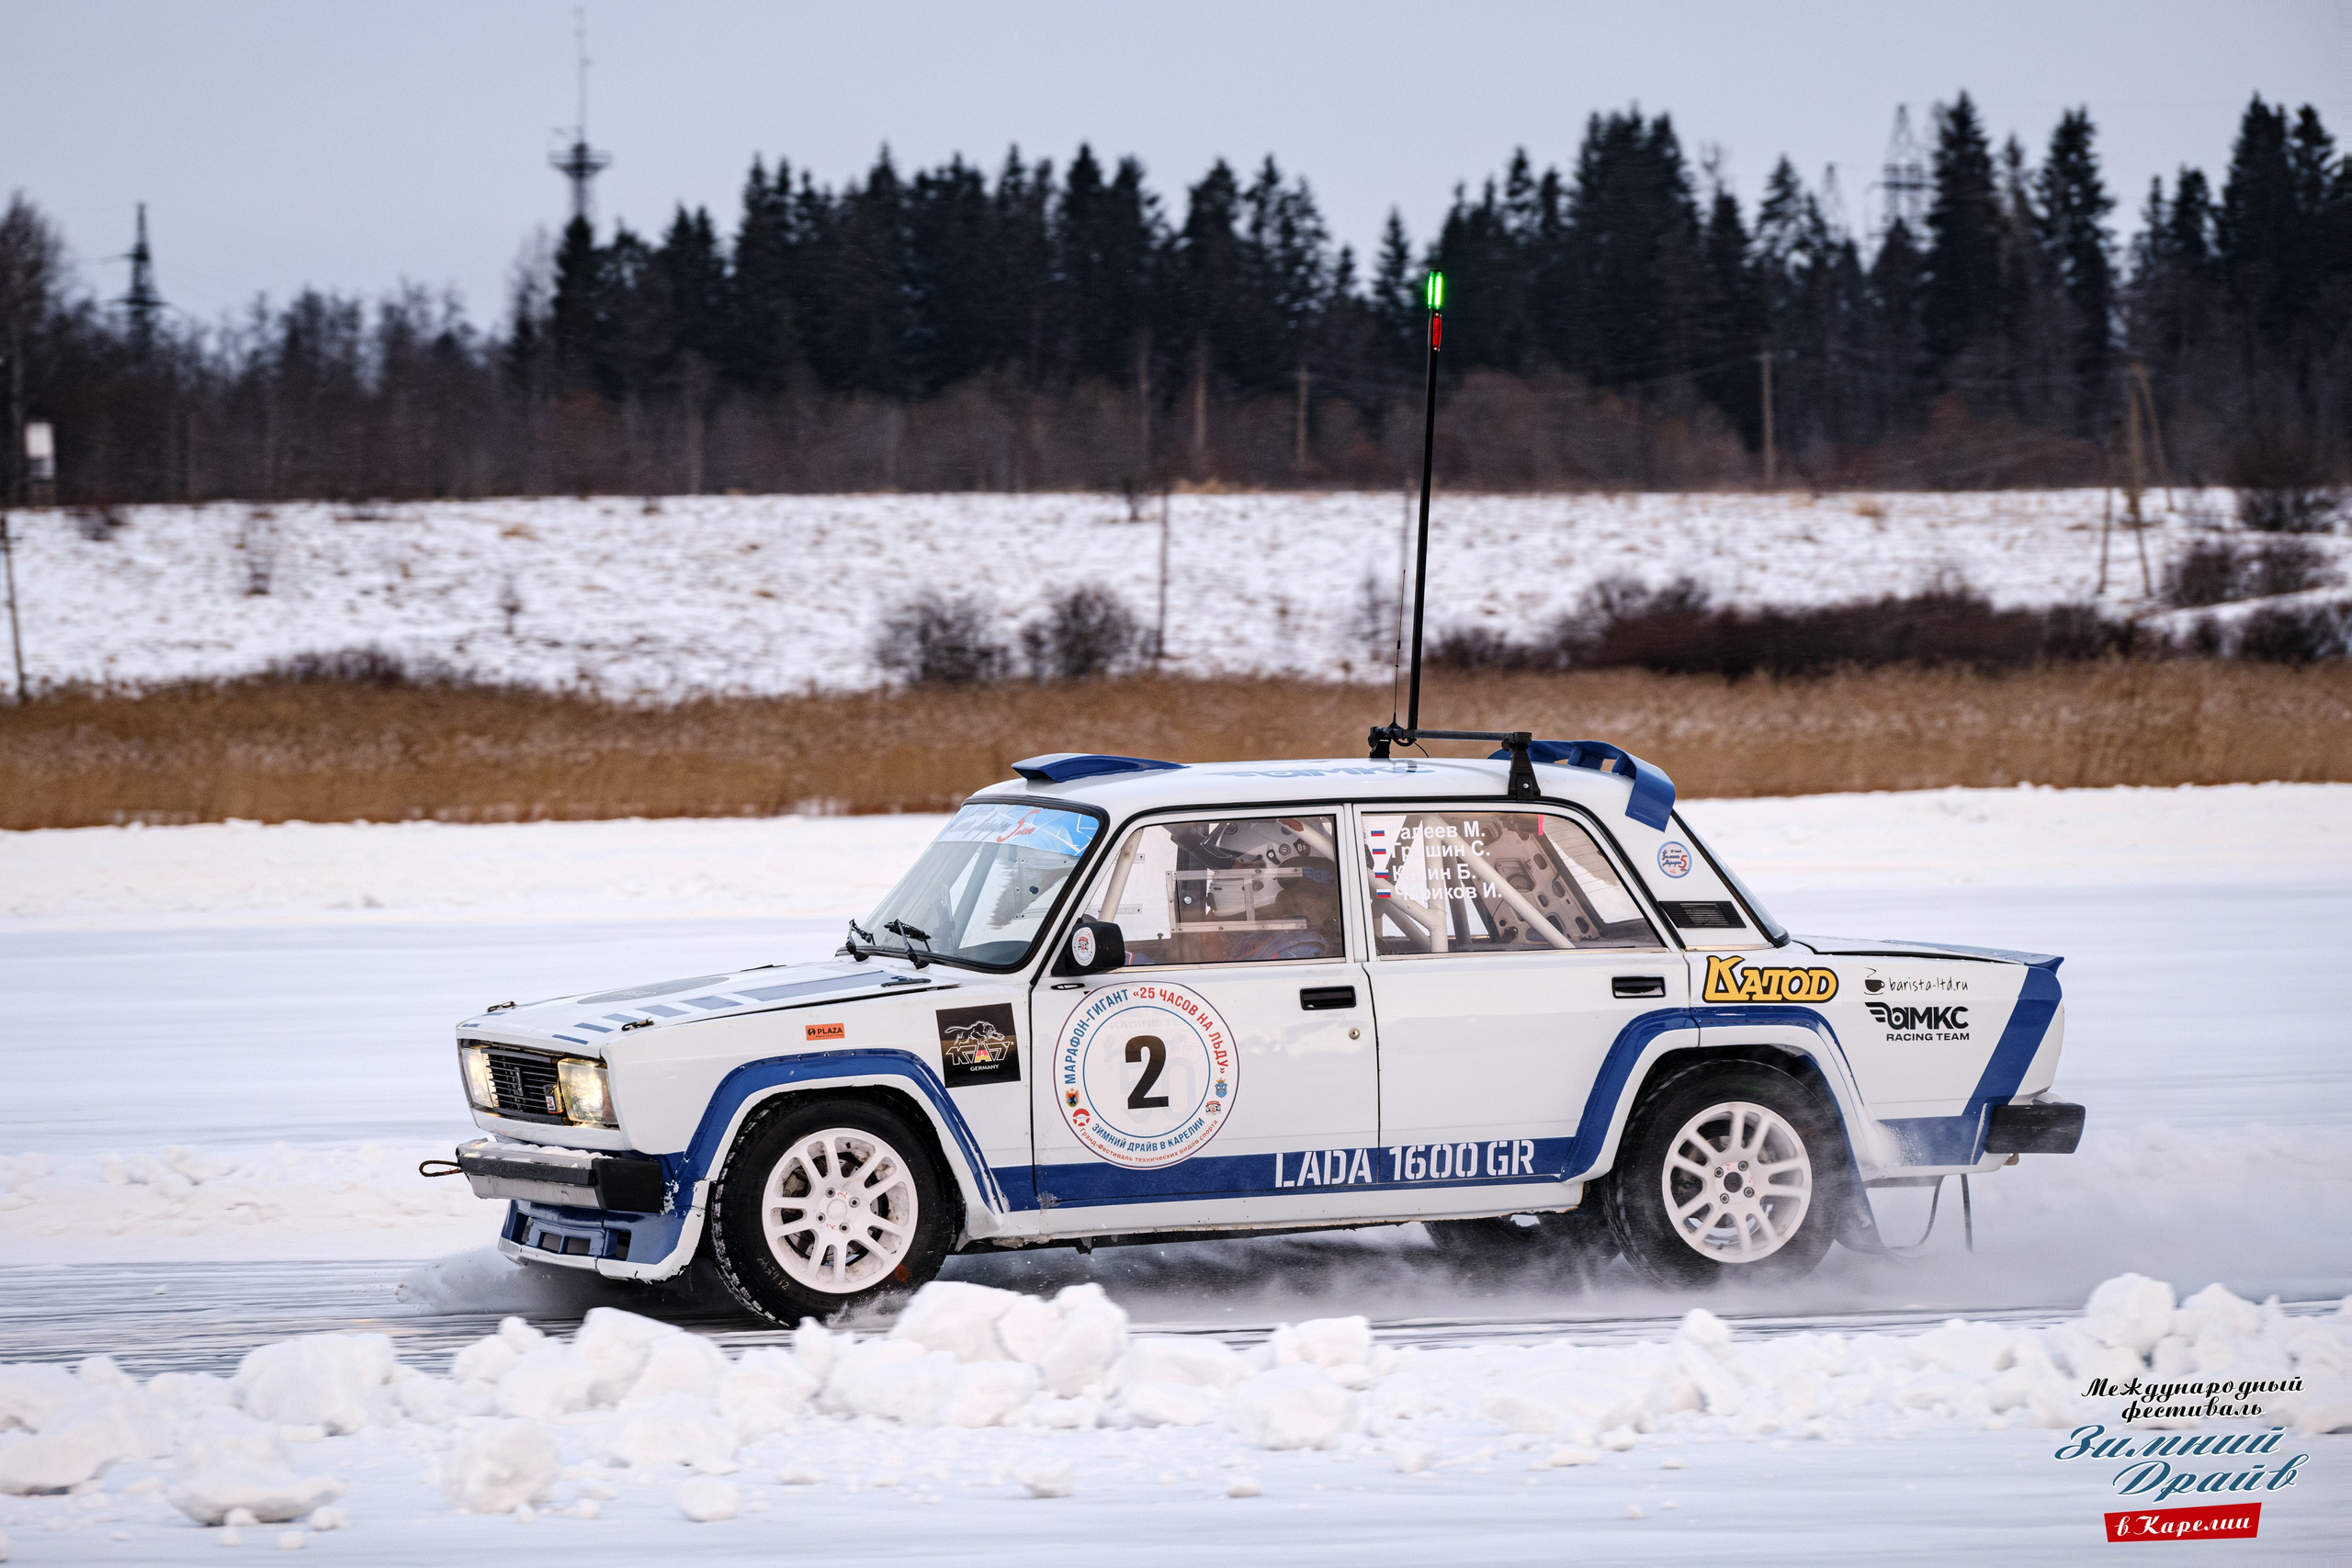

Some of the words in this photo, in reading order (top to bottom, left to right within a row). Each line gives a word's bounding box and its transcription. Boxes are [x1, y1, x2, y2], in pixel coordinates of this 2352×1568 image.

[1463, 820, 1486, 838] М.
[1391, 841, 1465, 863] Гршин
[1471, 840, 1490, 857] С.
[1456, 863, 1476, 879] Б.
[1482, 882, 1502, 898] И.
[1888, 976, 1969, 992] barista-ltd.ru
[817, 1027, 843, 1035] PLAZA
[1064, 988, 1129, 1085] МАРАФОН-ГИГАНТ
[1133, 987, 1156, 999] «25
[1159, 988, 1199, 1016] ЧАСОВ
[1196, 1012, 1214, 1032] НА
[1886, 1033, 1934, 1042] RACING
[1936, 1032, 1970, 1041] TEAM
[970, 1064, 1000, 1072] GERMANY
[1125, 1034, 1170, 1110] 2
[1091, 1122, 1126, 1149] ЗИМНИЙ
[1126, 1141, 1159, 1153] ДРАЙВ
[1159, 1141, 1167, 1150] В
[1168, 1117, 1205, 1148] КАРЕЛИИ
[1179, 1140, 1200, 1154] видов
[1199, 1119, 1218, 1142] спорта
[1274, 1148, 1373, 1188] LADA
[1388, 1142, 1479, 1181] 1600
[1486, 1139, 1535, 1177] GR
